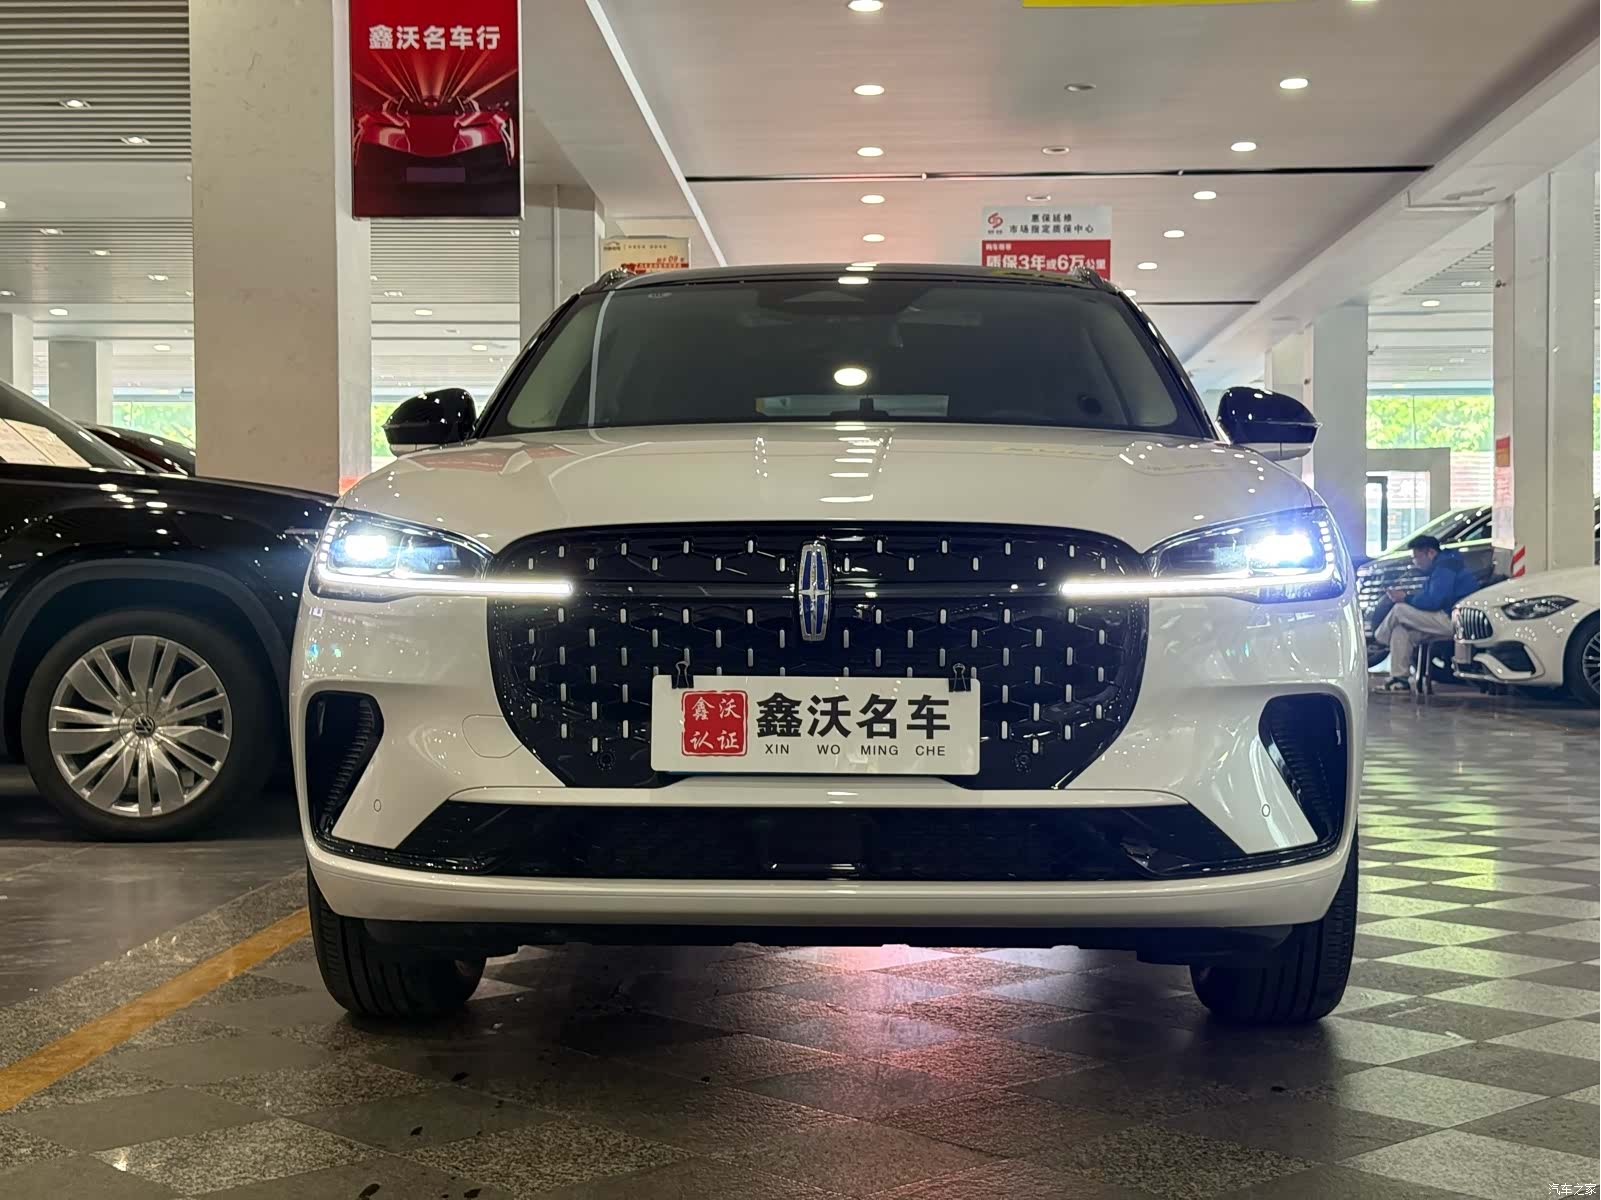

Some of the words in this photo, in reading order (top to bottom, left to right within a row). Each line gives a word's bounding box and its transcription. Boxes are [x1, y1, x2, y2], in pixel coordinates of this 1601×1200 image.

[368, 24, 500, 50] 鑫沃名车行
[1009, 224, 1094, 234] 市场指定质保中心
[691, 696, 741, 720] 鑫沃
[756, 692, 951, 740] 鑫沃名车
[690, 729, 740, 750] 认证
[765, 744, 790, 755] XIN
[817, 744, 841, 755] WO
[860, 745, 899, 756] MING
[915, 745, 946, 756] CHE
